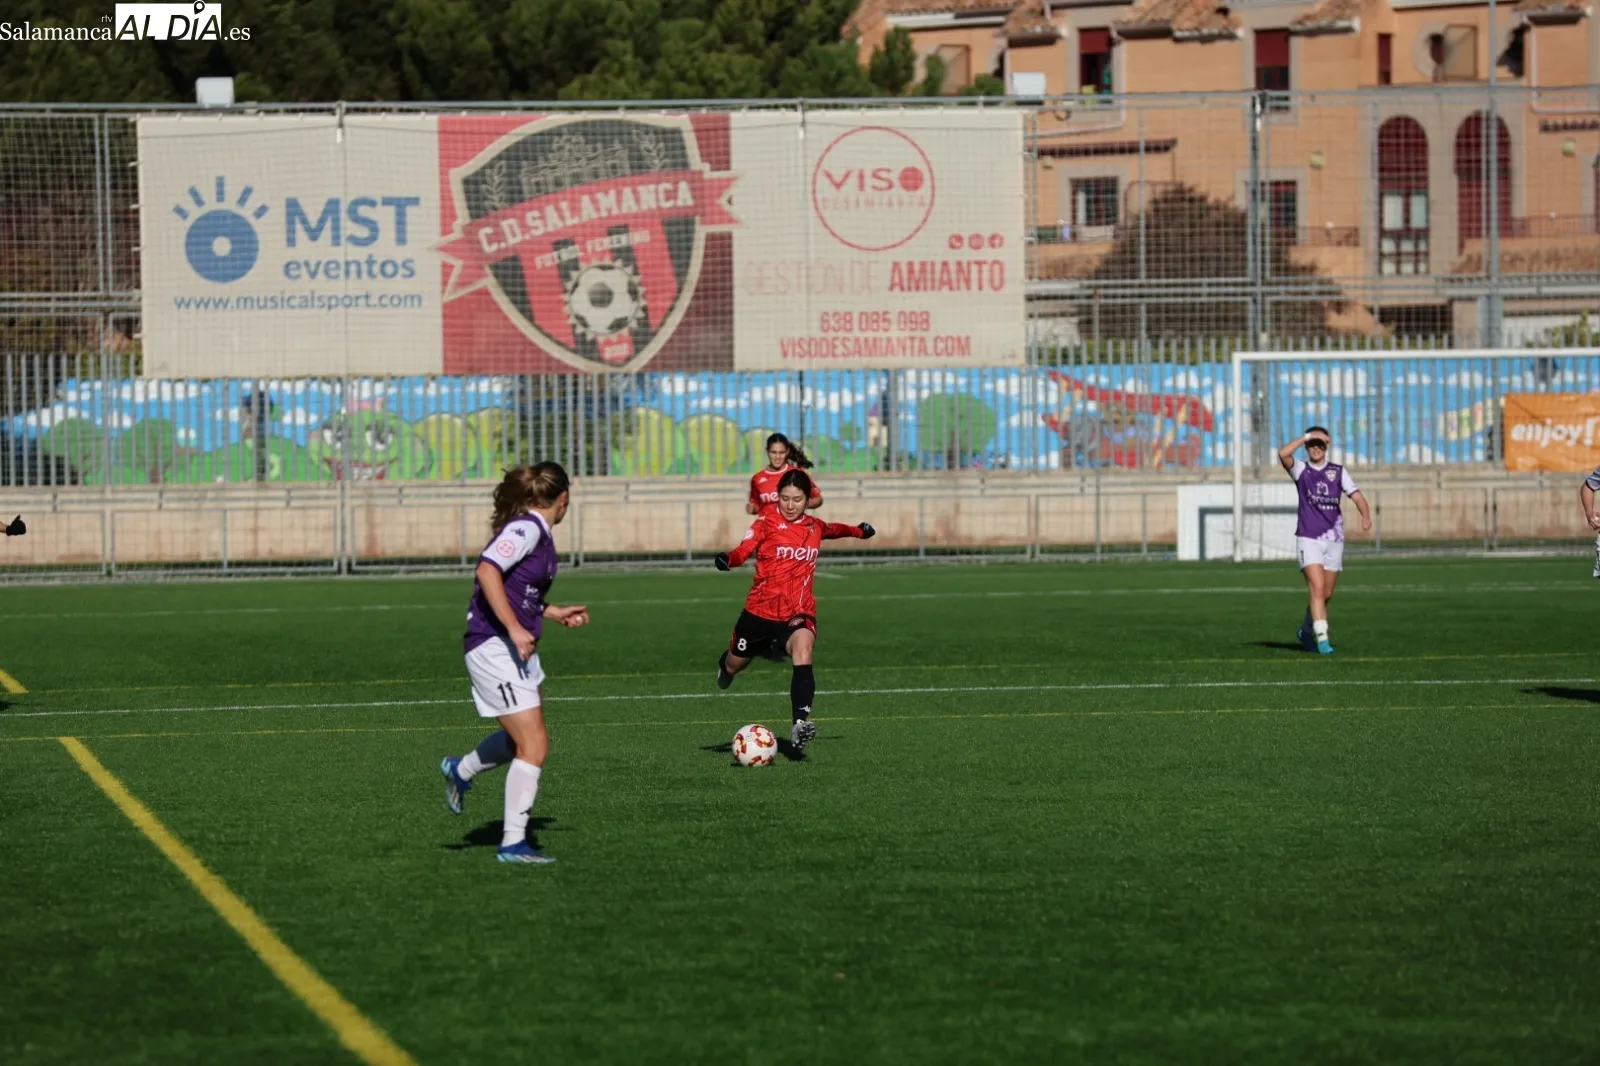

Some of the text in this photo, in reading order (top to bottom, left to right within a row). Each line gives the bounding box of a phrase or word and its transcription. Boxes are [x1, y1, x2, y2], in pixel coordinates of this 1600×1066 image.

[822, 166, 925, 192] VISO
[285, 196, 421, 248] MST
[283, 253, 416, 281] eventos
[888, 258, 1005, 293] AMIANTO
[173, 290, 424, 312] www.musicalsport.com
[820, 310, 931, 333] 638 085 098
[737, 637, 748, 652] 8
[497, 681, 518, 709] 11
